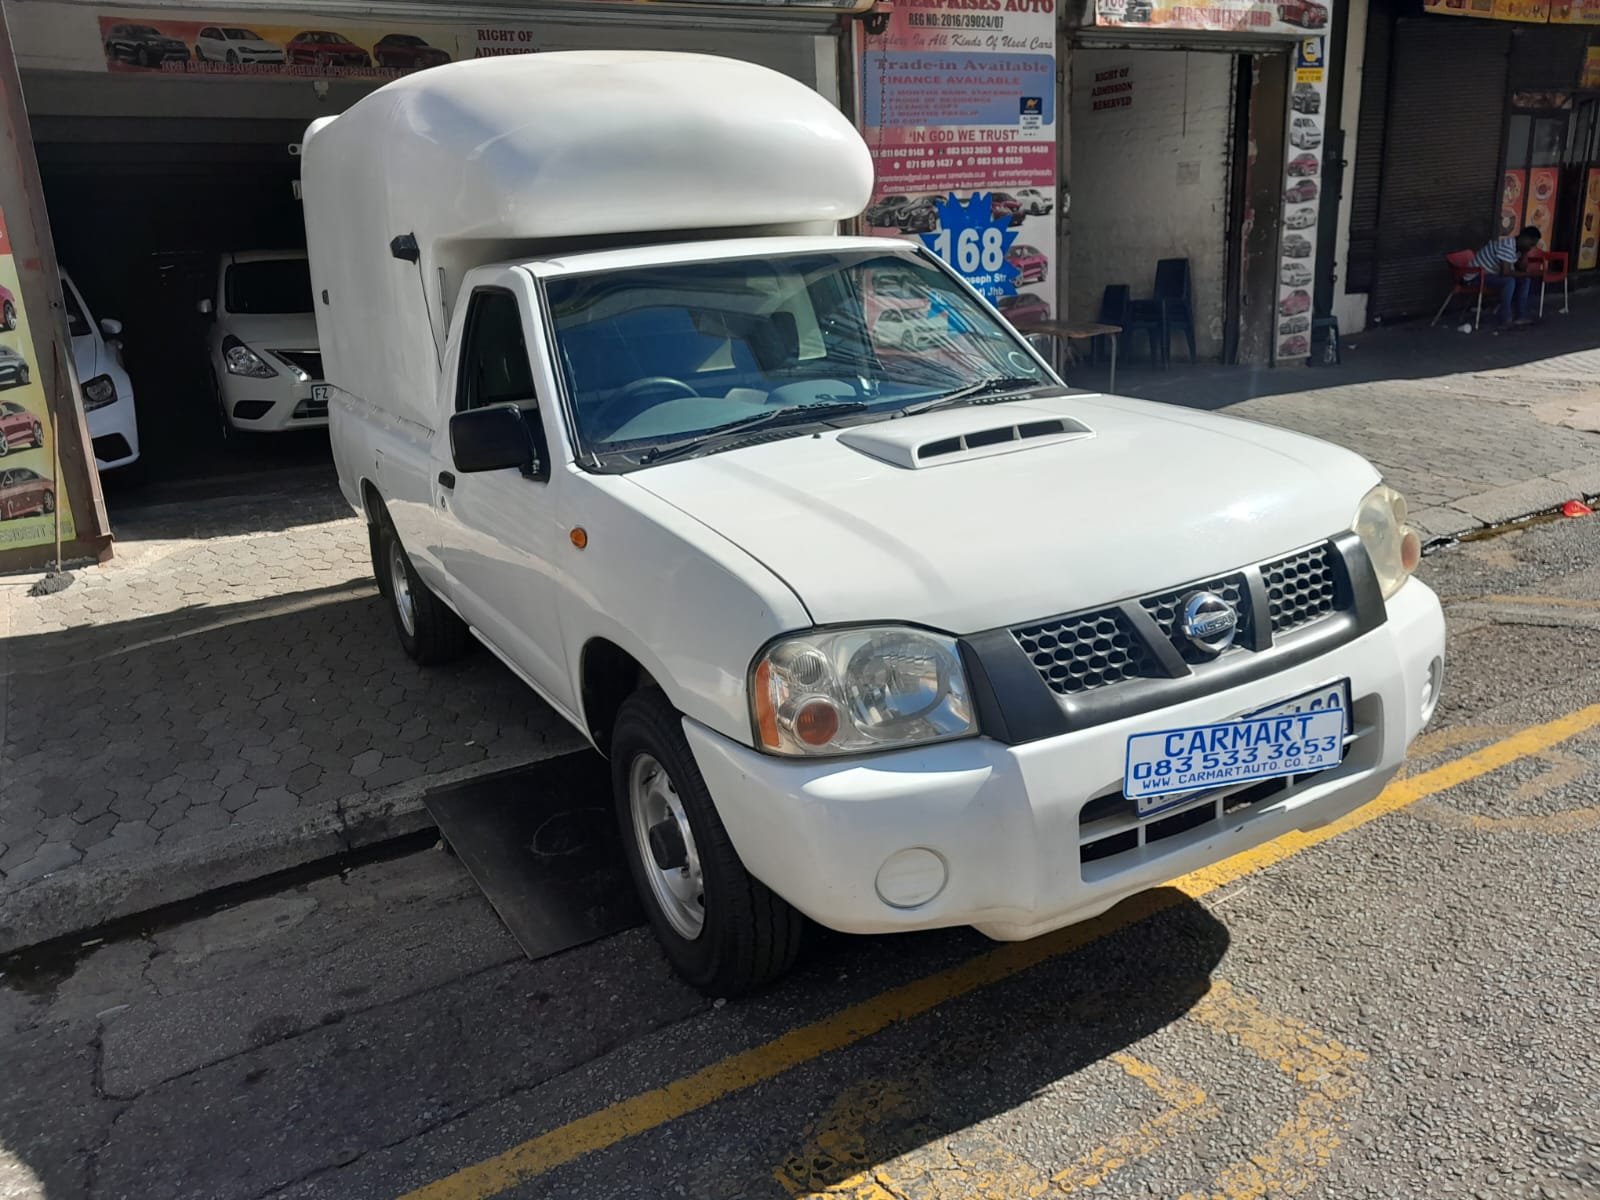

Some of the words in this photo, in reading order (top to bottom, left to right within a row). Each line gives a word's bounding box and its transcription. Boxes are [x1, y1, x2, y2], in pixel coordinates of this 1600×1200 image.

[1004, 0, 1054, 13] AUTO
[909, 13, 925, 26] REG
[941, 14, 1004, 28] 2016/39024/07
[477, 29, 515, 41] RIGHT
[518, 31, 533, 41] OF
[928, 34, 948, 46] All
[951, 34, 982, 47] Kinds
[986, 35, 998, 50] Of
[1001, 36, 1028, 48] Used
[1030, 37, 1053, 50] Cars
[874, 59, 957, 70] Trade-in
[964, 60, 1049, 72] Available
[880, 76, 943, 84] FINANCE
[947, 76, 1021, 85] AVAILABLE
[929, 130, 954, 142] GOD
[958, 130, 975, 141] WE
[934, 227, 1004, 273] 168
[994, 272, 1007, 283] Str
[987, 286, 1004, 297] Jhb
[1192, 613, 1235, 636] NISSAN
[1164, 716, 1313, 758] CARMART
[1133, 755, 1193, 780] 083
[1202, 746, 1258, 770] 533
[1267, 735, 1336, 759] 3653
[1308, 754, 1323, 765] ZA
